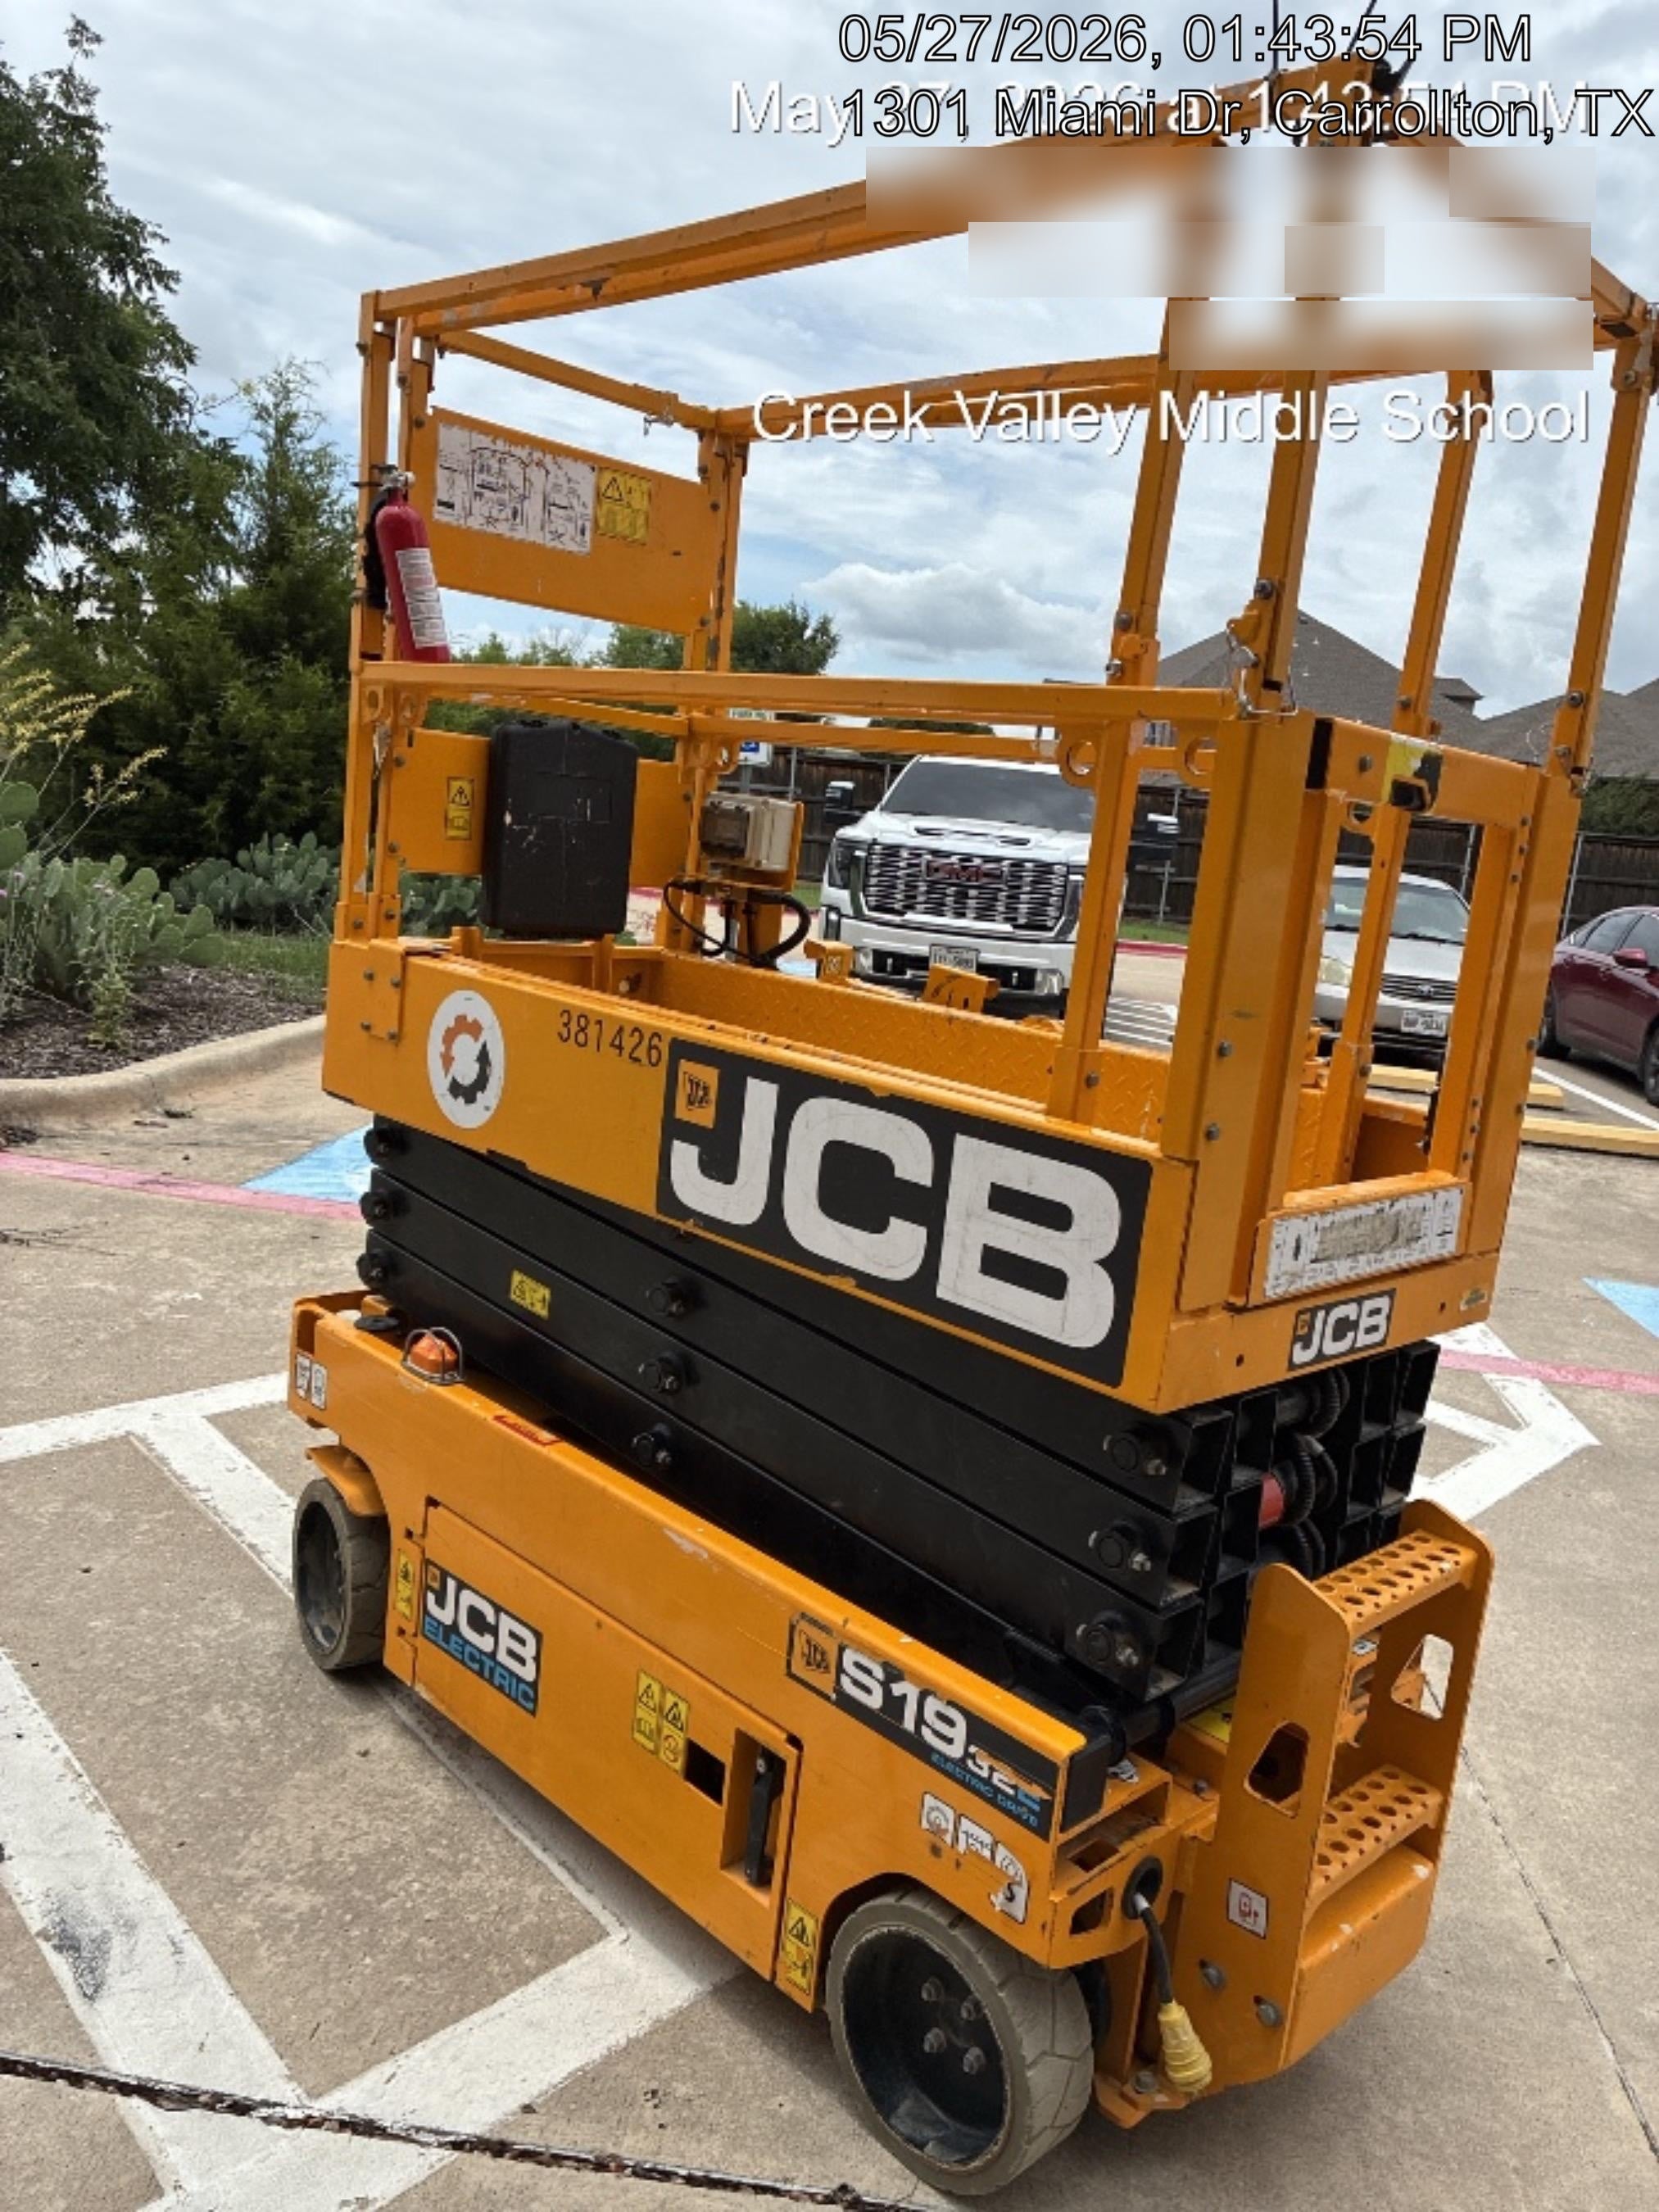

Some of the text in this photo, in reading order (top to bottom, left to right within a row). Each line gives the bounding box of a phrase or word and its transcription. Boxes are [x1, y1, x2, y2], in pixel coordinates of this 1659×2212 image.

[557, 1009, 663, 1067] 381426
[669, 1075, 1122, 1349] JCB
[1292, 1294, 1391, 1365] JCB
[424, 1616, 535, 1713] ELECTRIC
[426, 1575, 537, 1683] JCB
